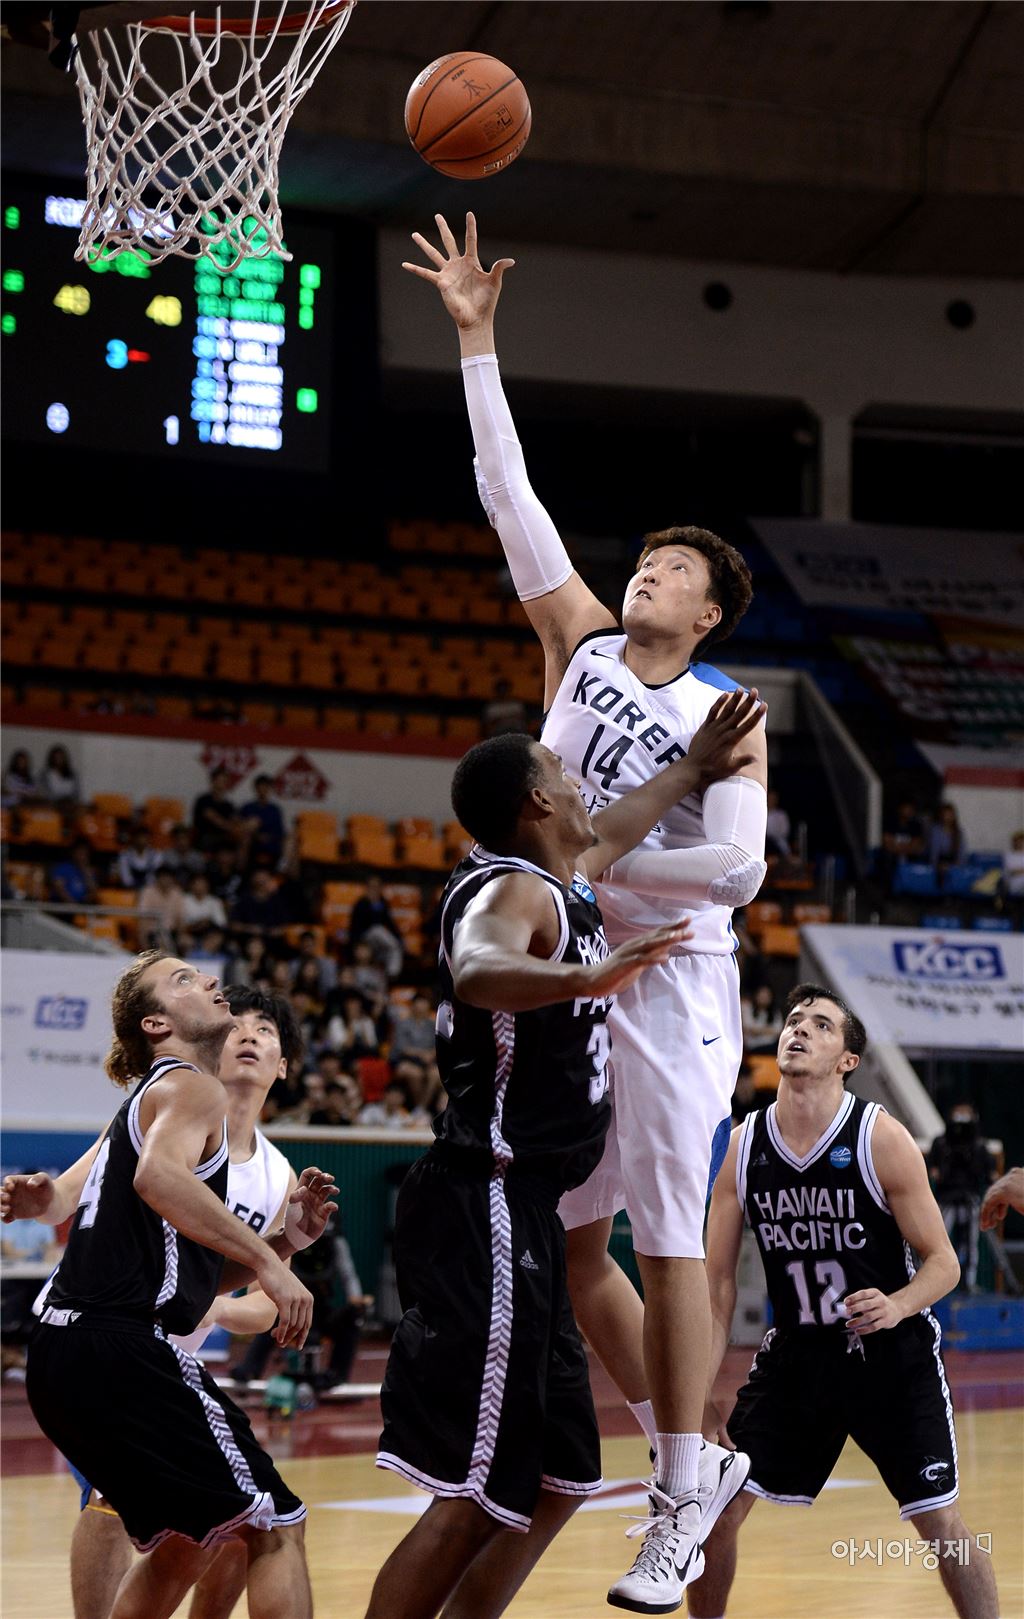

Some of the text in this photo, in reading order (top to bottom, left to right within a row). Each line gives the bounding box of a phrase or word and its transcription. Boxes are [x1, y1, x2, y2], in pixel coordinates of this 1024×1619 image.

[581, 723, 635, 790] 14
[902, 942, 996, 978] KCC
[586, 1022, 610, 1105] 3
[758, 1220, 867, 1252] PACIFIC
[786, 1258, 852, 1326] 12
